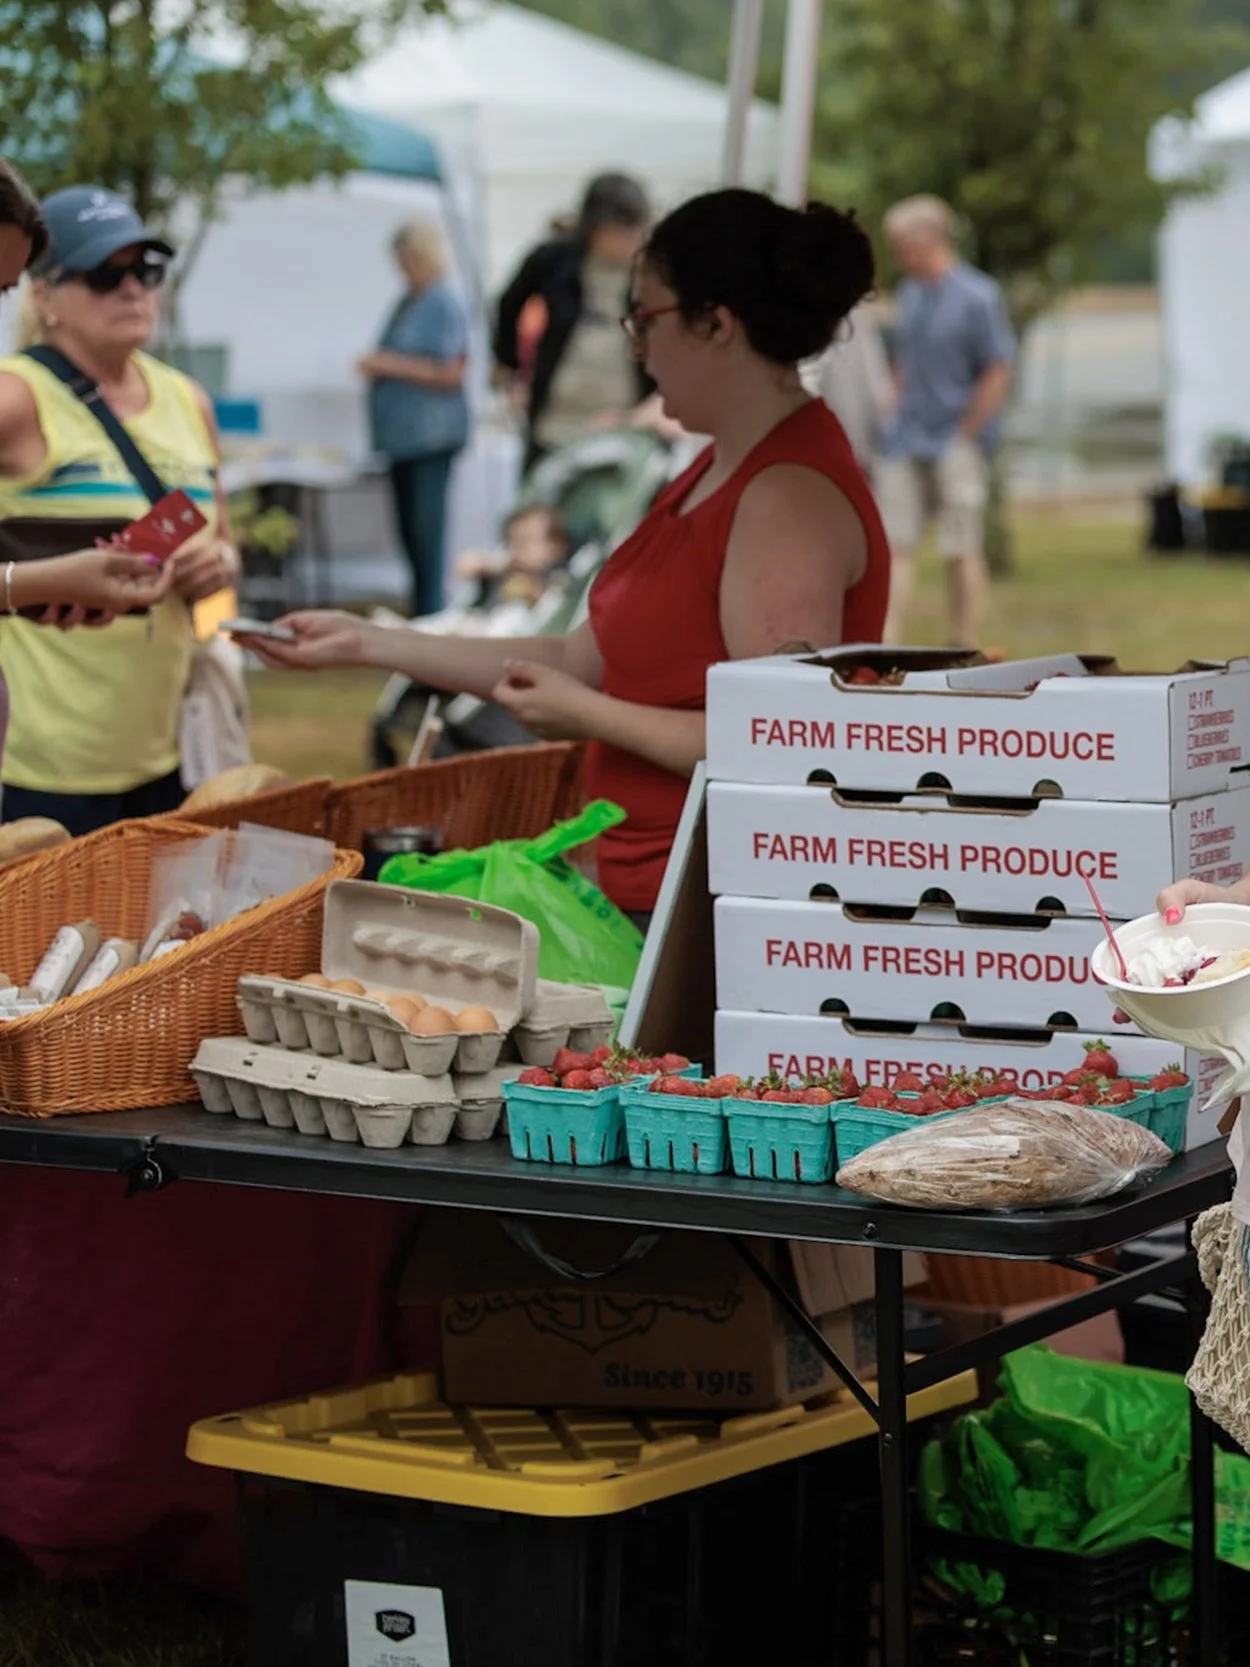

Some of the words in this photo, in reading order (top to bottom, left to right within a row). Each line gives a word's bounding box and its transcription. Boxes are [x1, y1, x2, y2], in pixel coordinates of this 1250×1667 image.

[751, 718, 836, 749] FARM
[846, 722, 947, 754] FRESH
[958, 727, 1115, 761] PRODUCE
[753, 832, 837, 864] FARM
[848, 838, 949, 870] FRESH
[960, 845, 1118, 879] PRODUCE
[766, 939, 852, 971] FARM
[863, 945, 965, 977] FRESH
[976, 951, 1109, 986] PRODU
[978, 1066, 1066, 1087] PROD
[603, 1361, 687, 1390] Since
[696, 1369, 754, 1396] 1915
